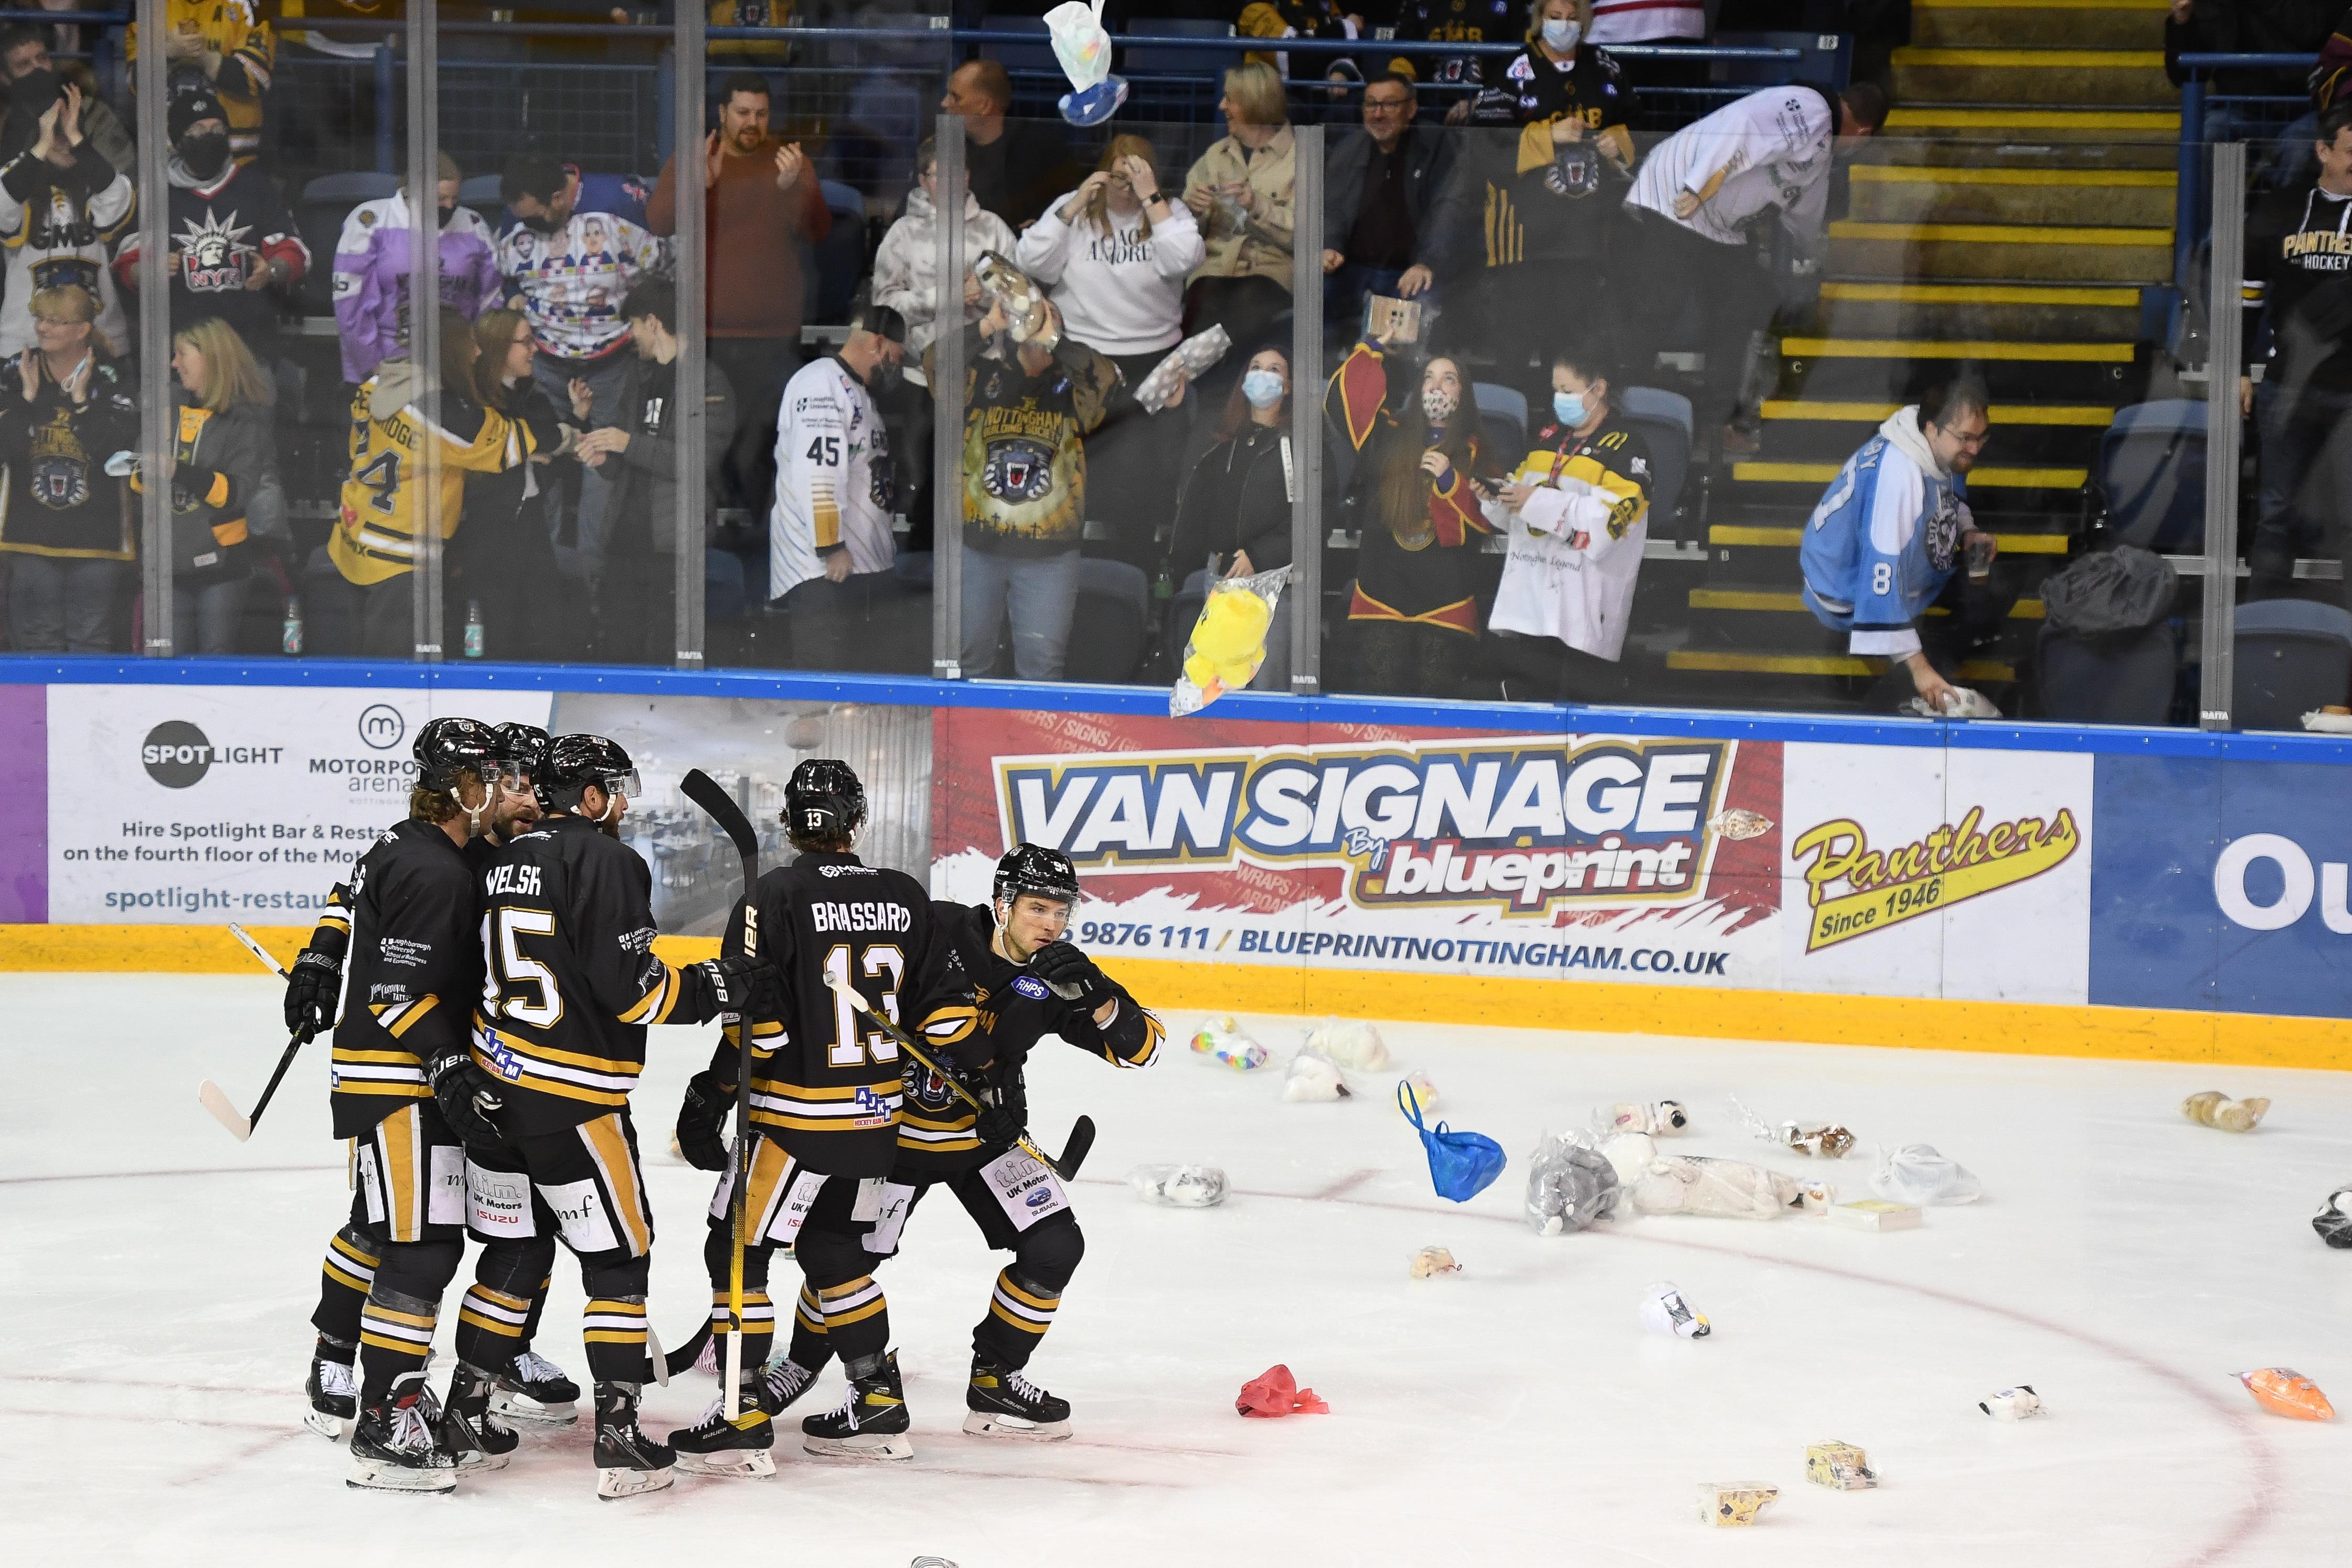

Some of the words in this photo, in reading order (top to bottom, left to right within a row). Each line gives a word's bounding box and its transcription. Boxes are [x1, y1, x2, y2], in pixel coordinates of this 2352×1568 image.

[2304, 254, 2350, 270] HOCKEY
[806, 436, 840, 466] 45
[1872, 561, 1892, 596] 8
[143, 744, 283, 765] SPOTLIGHT
[348, 776, 414, 793] arena
[1017, 771, 1236, 852] VAN
[1245, 753, 1711, 847] SIGNAGE
[122, 822, 164, 837] Hire
[170, 822, 265, 841] Spotlight
[272, 824, 306, 839] Bar
[312, 825, 324, 839] &
[806, 812, 822, 827] 13
[63, 848, 89, 860] on
[95, 846, 129, 861] the
[134, 846, 199, 861] fourth
[205, 847, 253, 862] floor
[259, 847, 279, 862] of
[284, 848, 317, 863] the
[1345, 827, 1388, 873] By
[1792, 806, 2080, 908] Panthers
[1053, 861, 1069, 874] 94
[1237, 865, 1293, 893] WRAPS
[1385, 837, 1692, 905] blueprint
[486, 864, 541, 897] WELSH
[811, 901, 911, 933] BRASSARD
[1819, 907, 1877, 939] Since
[1886, 878, 1941, 918] 1946
[405, 954, 428, 965] Business
[1081, 922, 1153, 946] 9876
[1160, 925, 1209, 950] 111
[1238, 929, 1731, 976] BLUEPRINTNOTTINGHAM.CO.UK
[480, 906, 564, 1029] 15
[1016, 979, 1045, 997] RHPS
[823, 944, 905, 1068] 13
[1006, 1185, 1023, 1199] UK
[1022, 1174, 1049, 1190] Motors
[473, 1193, 485, 1206] UK
[486, 1198, 523, 1210] Motors
[558, 1194, 593, 1220] mf
[1031, 1200, 1059, 1217] SUBARU
[476, 1209, 519, 1224] ISUZU
[1002, 1397, 1028, 1413] BAUER
[702, 1426, 728, 1440] BAUER
